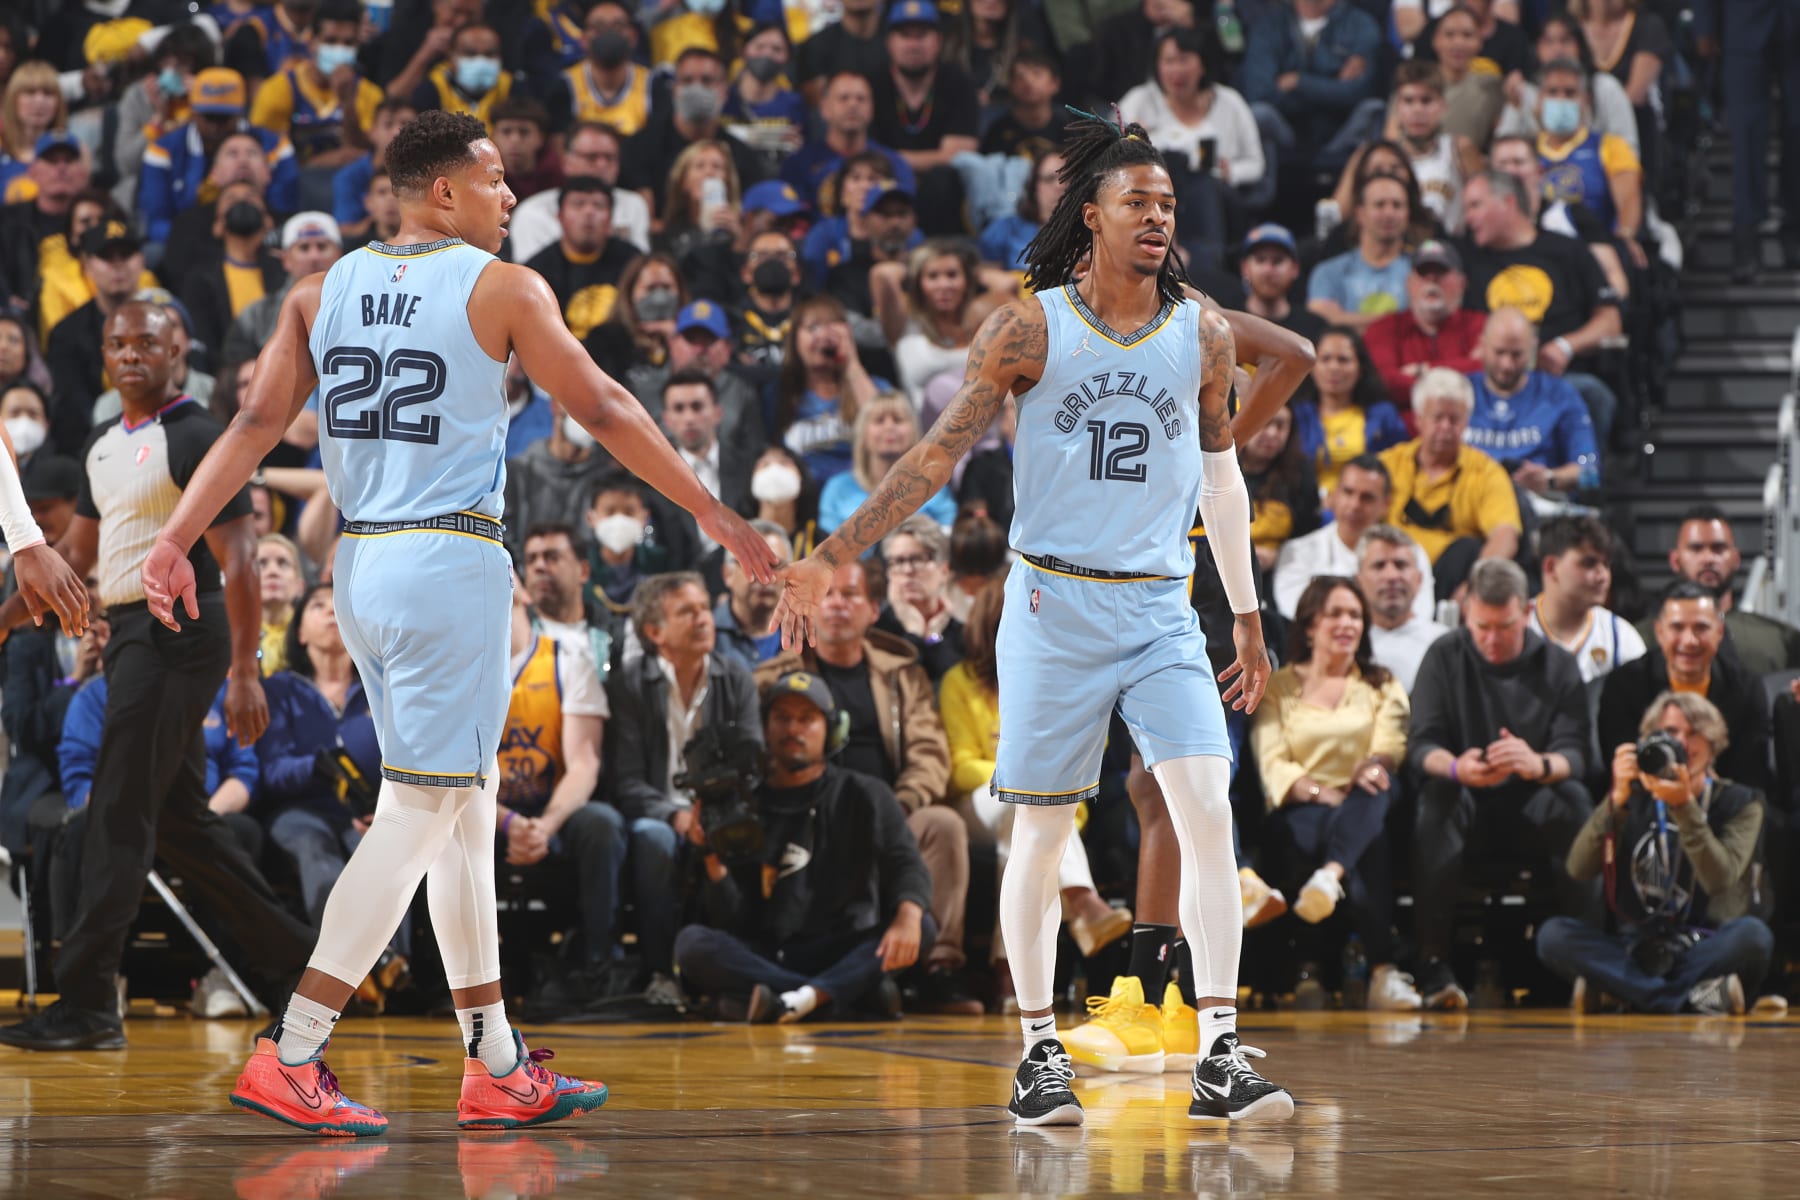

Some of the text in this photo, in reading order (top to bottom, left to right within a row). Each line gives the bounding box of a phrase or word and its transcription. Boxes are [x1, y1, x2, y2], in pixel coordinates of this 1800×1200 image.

[361, 292, 423, 328] BANE
[322, 346, 447, 446] 22
[1054, 371, 1182, 441] GRIZZLIES
[1087, 420, 1150, 483] 12
[496, 725, 544, 751] AY
[504, 756, 536, 783] 30
